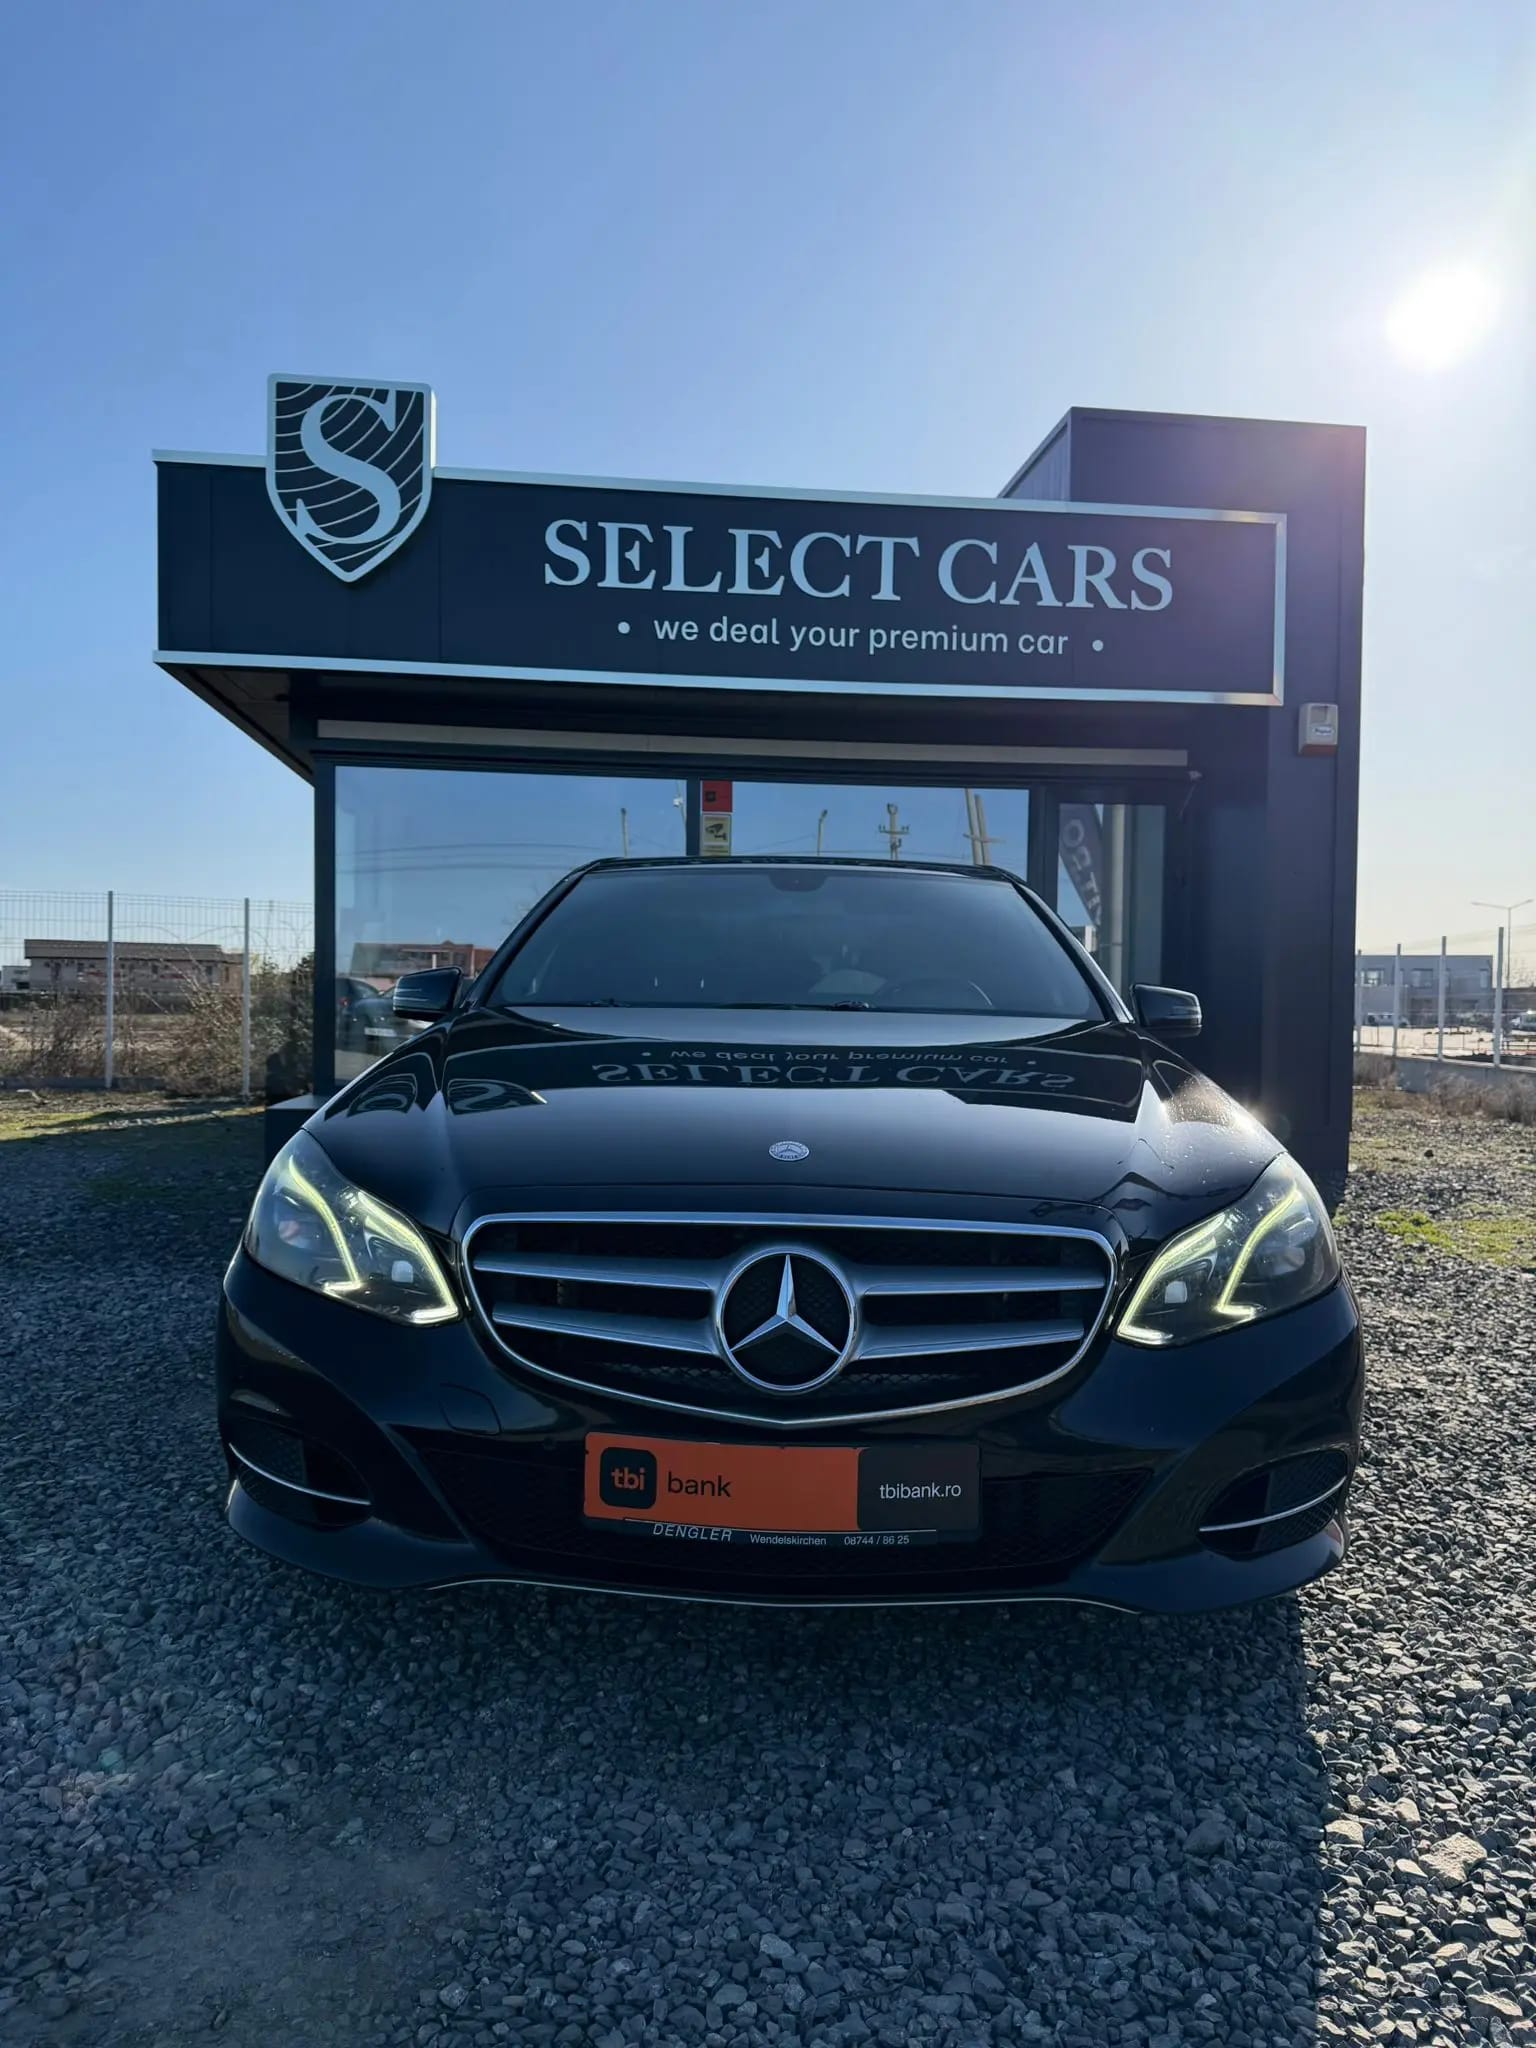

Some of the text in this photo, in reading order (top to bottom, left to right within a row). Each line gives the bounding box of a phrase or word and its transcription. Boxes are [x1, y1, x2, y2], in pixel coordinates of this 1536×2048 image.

[296, 386, 402, 544] S
[543, 519, 1174, 611] SELECT CARS
[654, 616, 1068, 655] we deal your premium car
[611, 1467, 731, 1497] tbi bank
[879, 1482, 962, 1499] tbibank.ro
[653, 1523, 732, 1541] DENGLER
[750, 1533, 827, 1545] Wendelskirchen
[844, 1536, 874, 1545] 08744
[882, 1536, 895, 1544] 86
[897, 1535, 910, 1544] 25
